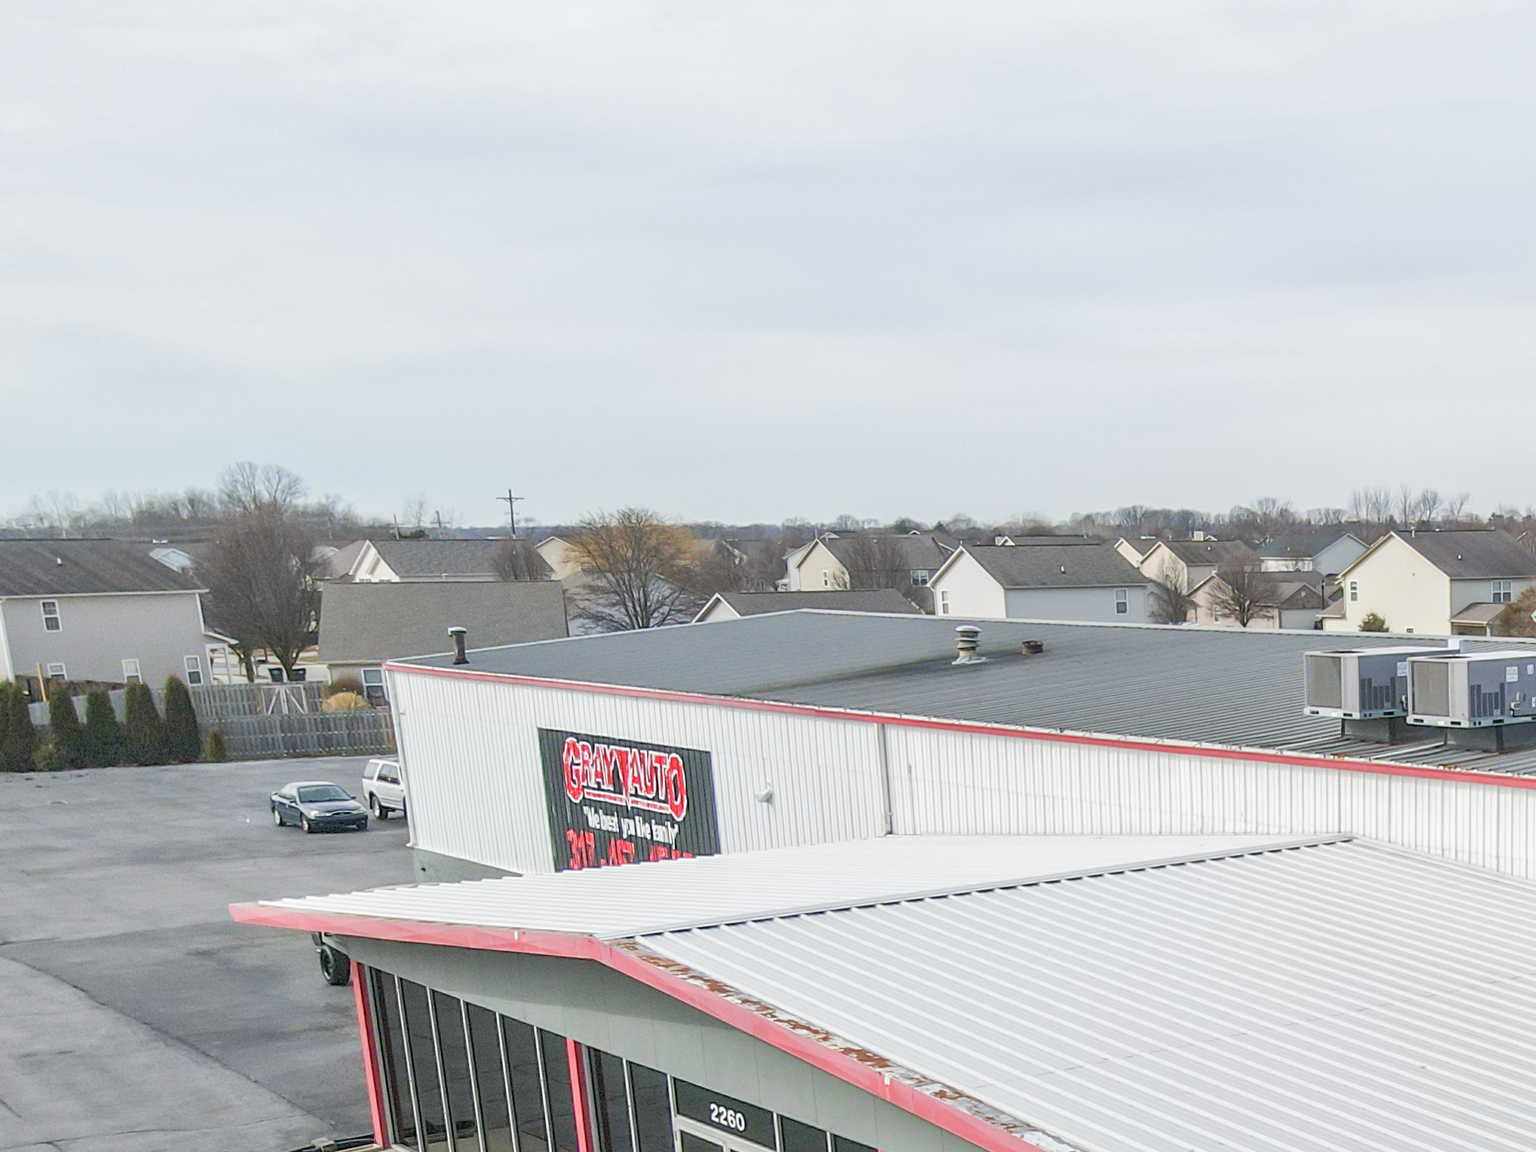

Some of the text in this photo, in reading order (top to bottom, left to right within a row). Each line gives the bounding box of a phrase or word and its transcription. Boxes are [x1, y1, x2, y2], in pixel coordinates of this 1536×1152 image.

[563, 737, 687, 822] GRAY AUTO
[709, 1103, 746, 1132] 2260
